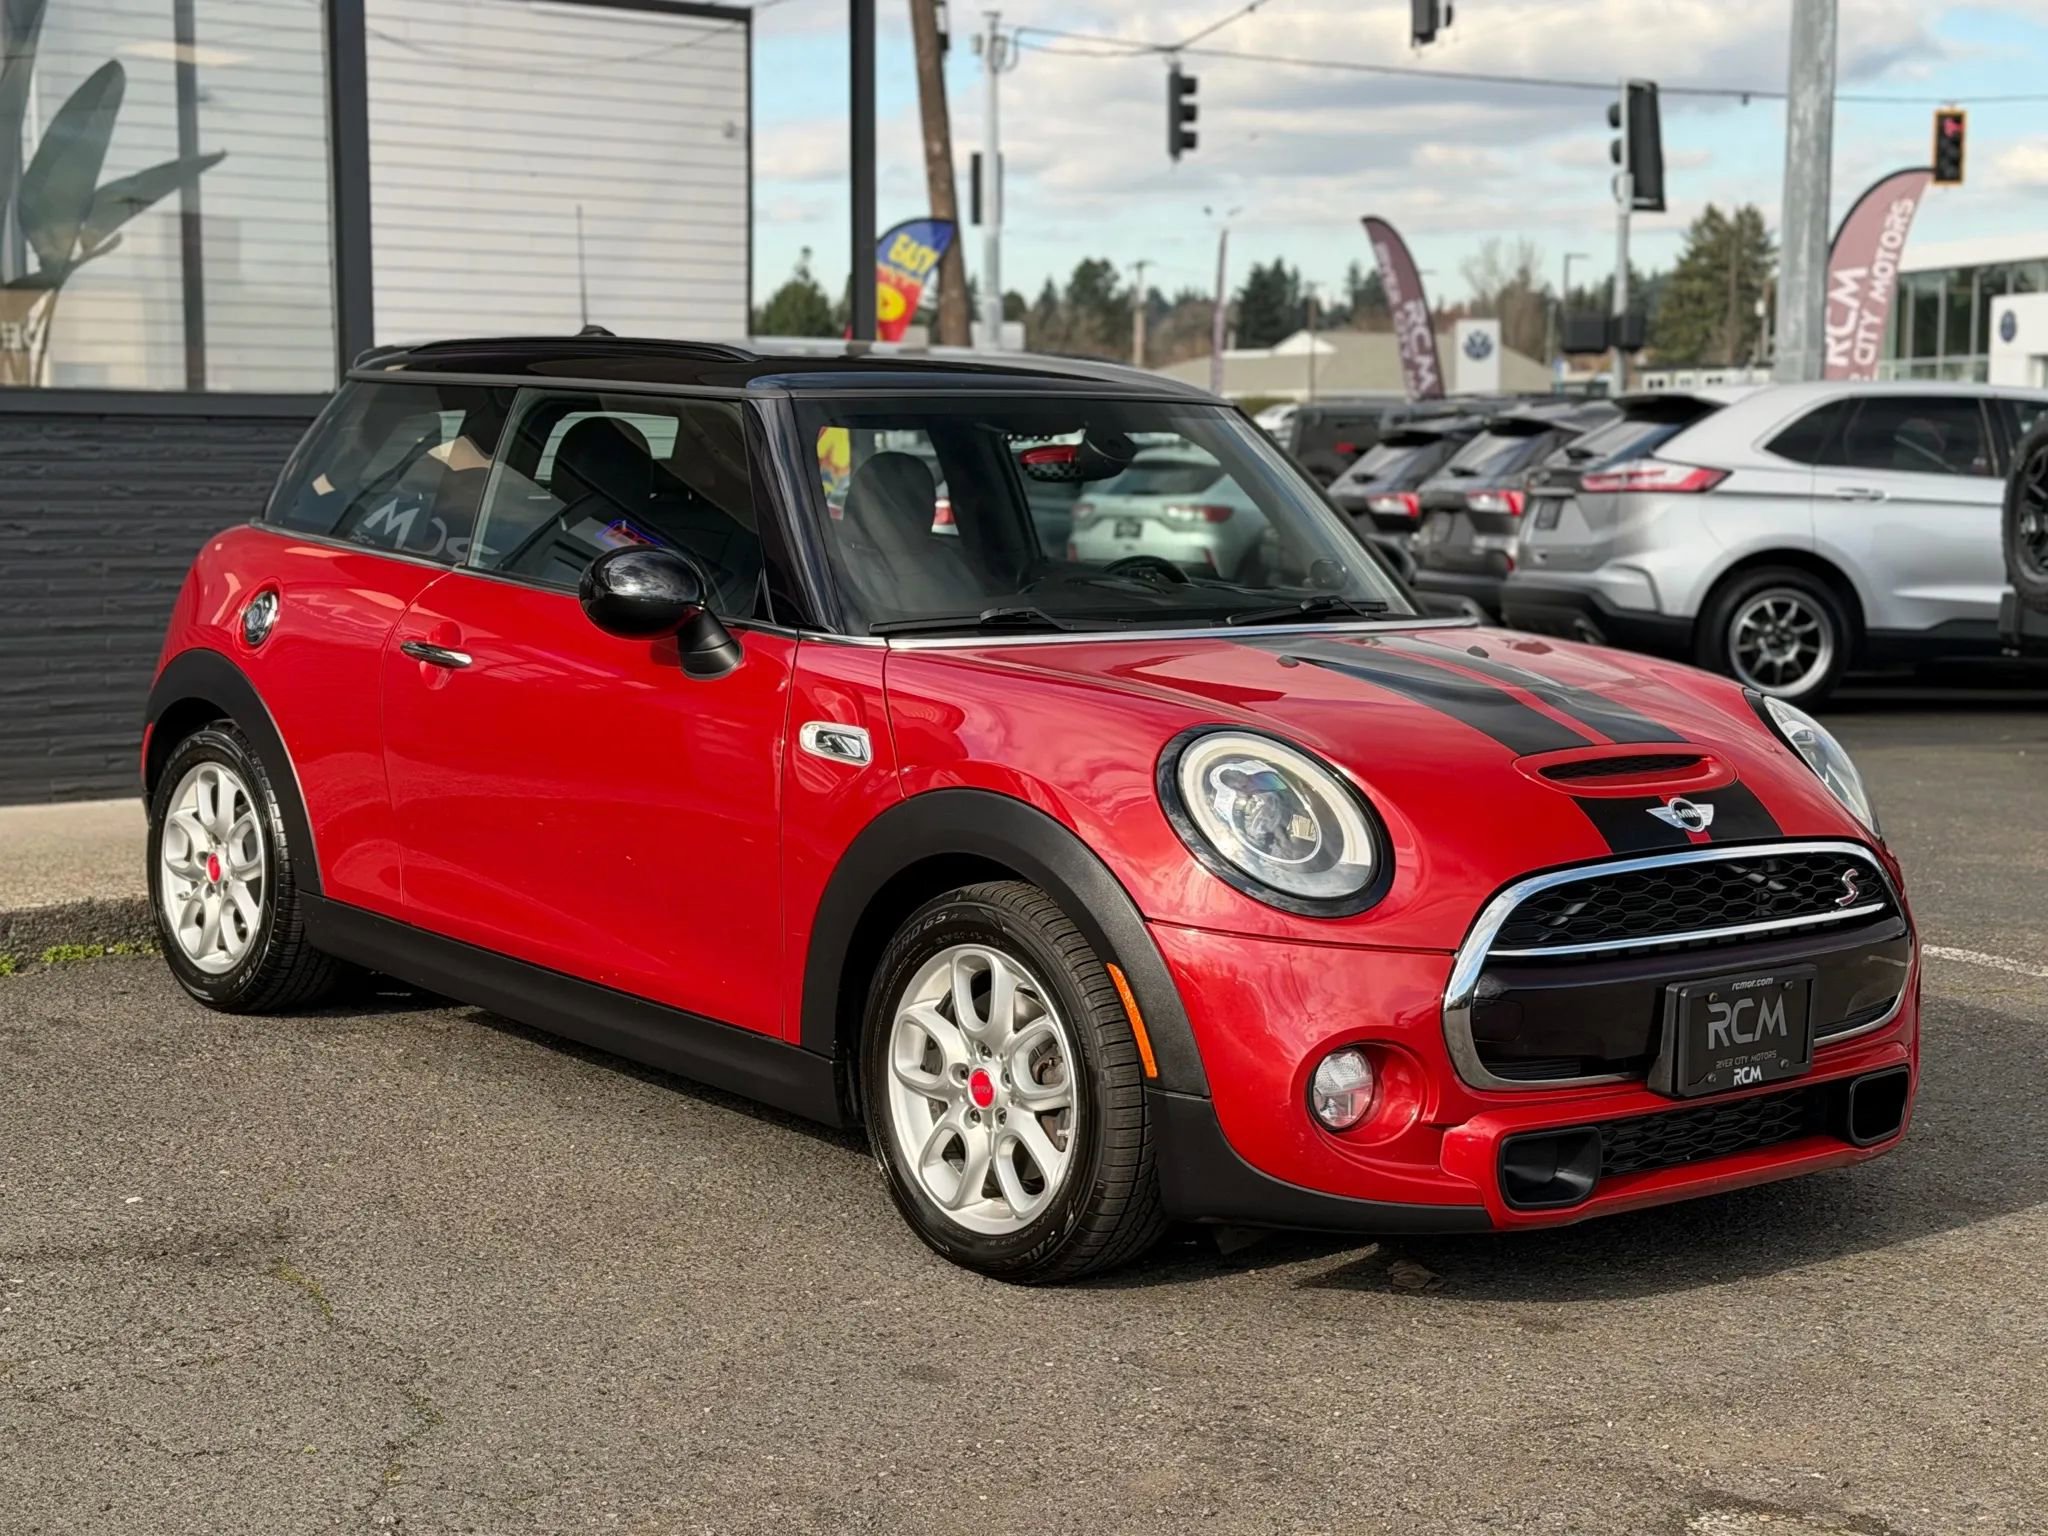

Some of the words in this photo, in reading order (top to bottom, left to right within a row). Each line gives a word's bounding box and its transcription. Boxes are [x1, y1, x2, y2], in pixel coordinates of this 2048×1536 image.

[1869, 198, 1915, 304] MOTORS
[1824, 266, 1868, 367] RCM
[1403, 299, 1438, 392] RCM
[1834, 868, 1859, 907] S
[1731, 977, 1774, 991] rcmor.com
[1707, 993, 1788, 1050] RCM
[1715, 1059, 1733, 1069] RIVER
[1734, 1056, 1749, 1066] CITY
[1750, 1050, 1777, 1062] MOTORS
[1733, 1065, 1763, 1086] RCM
